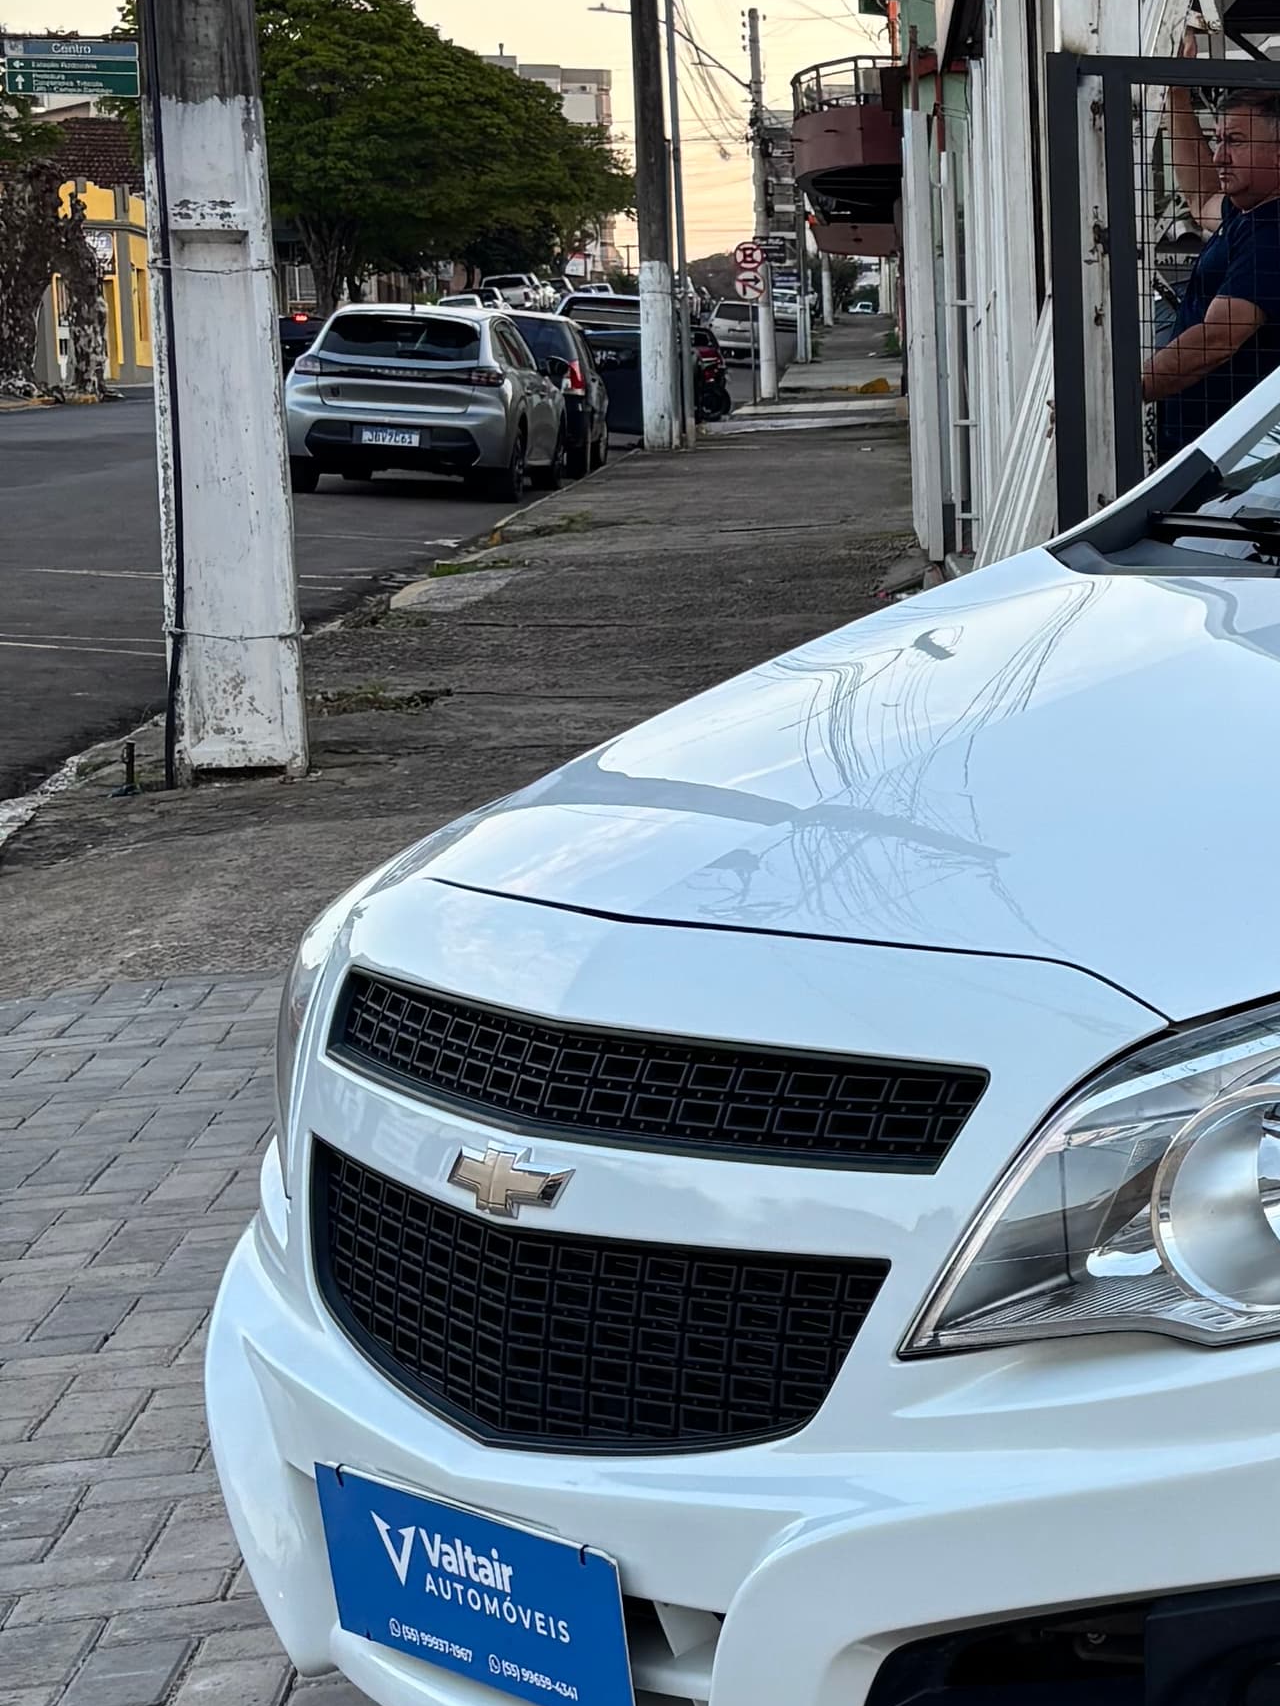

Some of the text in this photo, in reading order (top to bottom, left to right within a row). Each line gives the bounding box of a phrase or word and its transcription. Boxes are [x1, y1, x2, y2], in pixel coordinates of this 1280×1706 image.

[418, 1527, 514, 1595] Valtair
[425, 1572, 570, 1643] AUTOMÓVEIS
[402, 1624, 420, 1646] (55)
[501, 1659, 521, 1682] (55)
